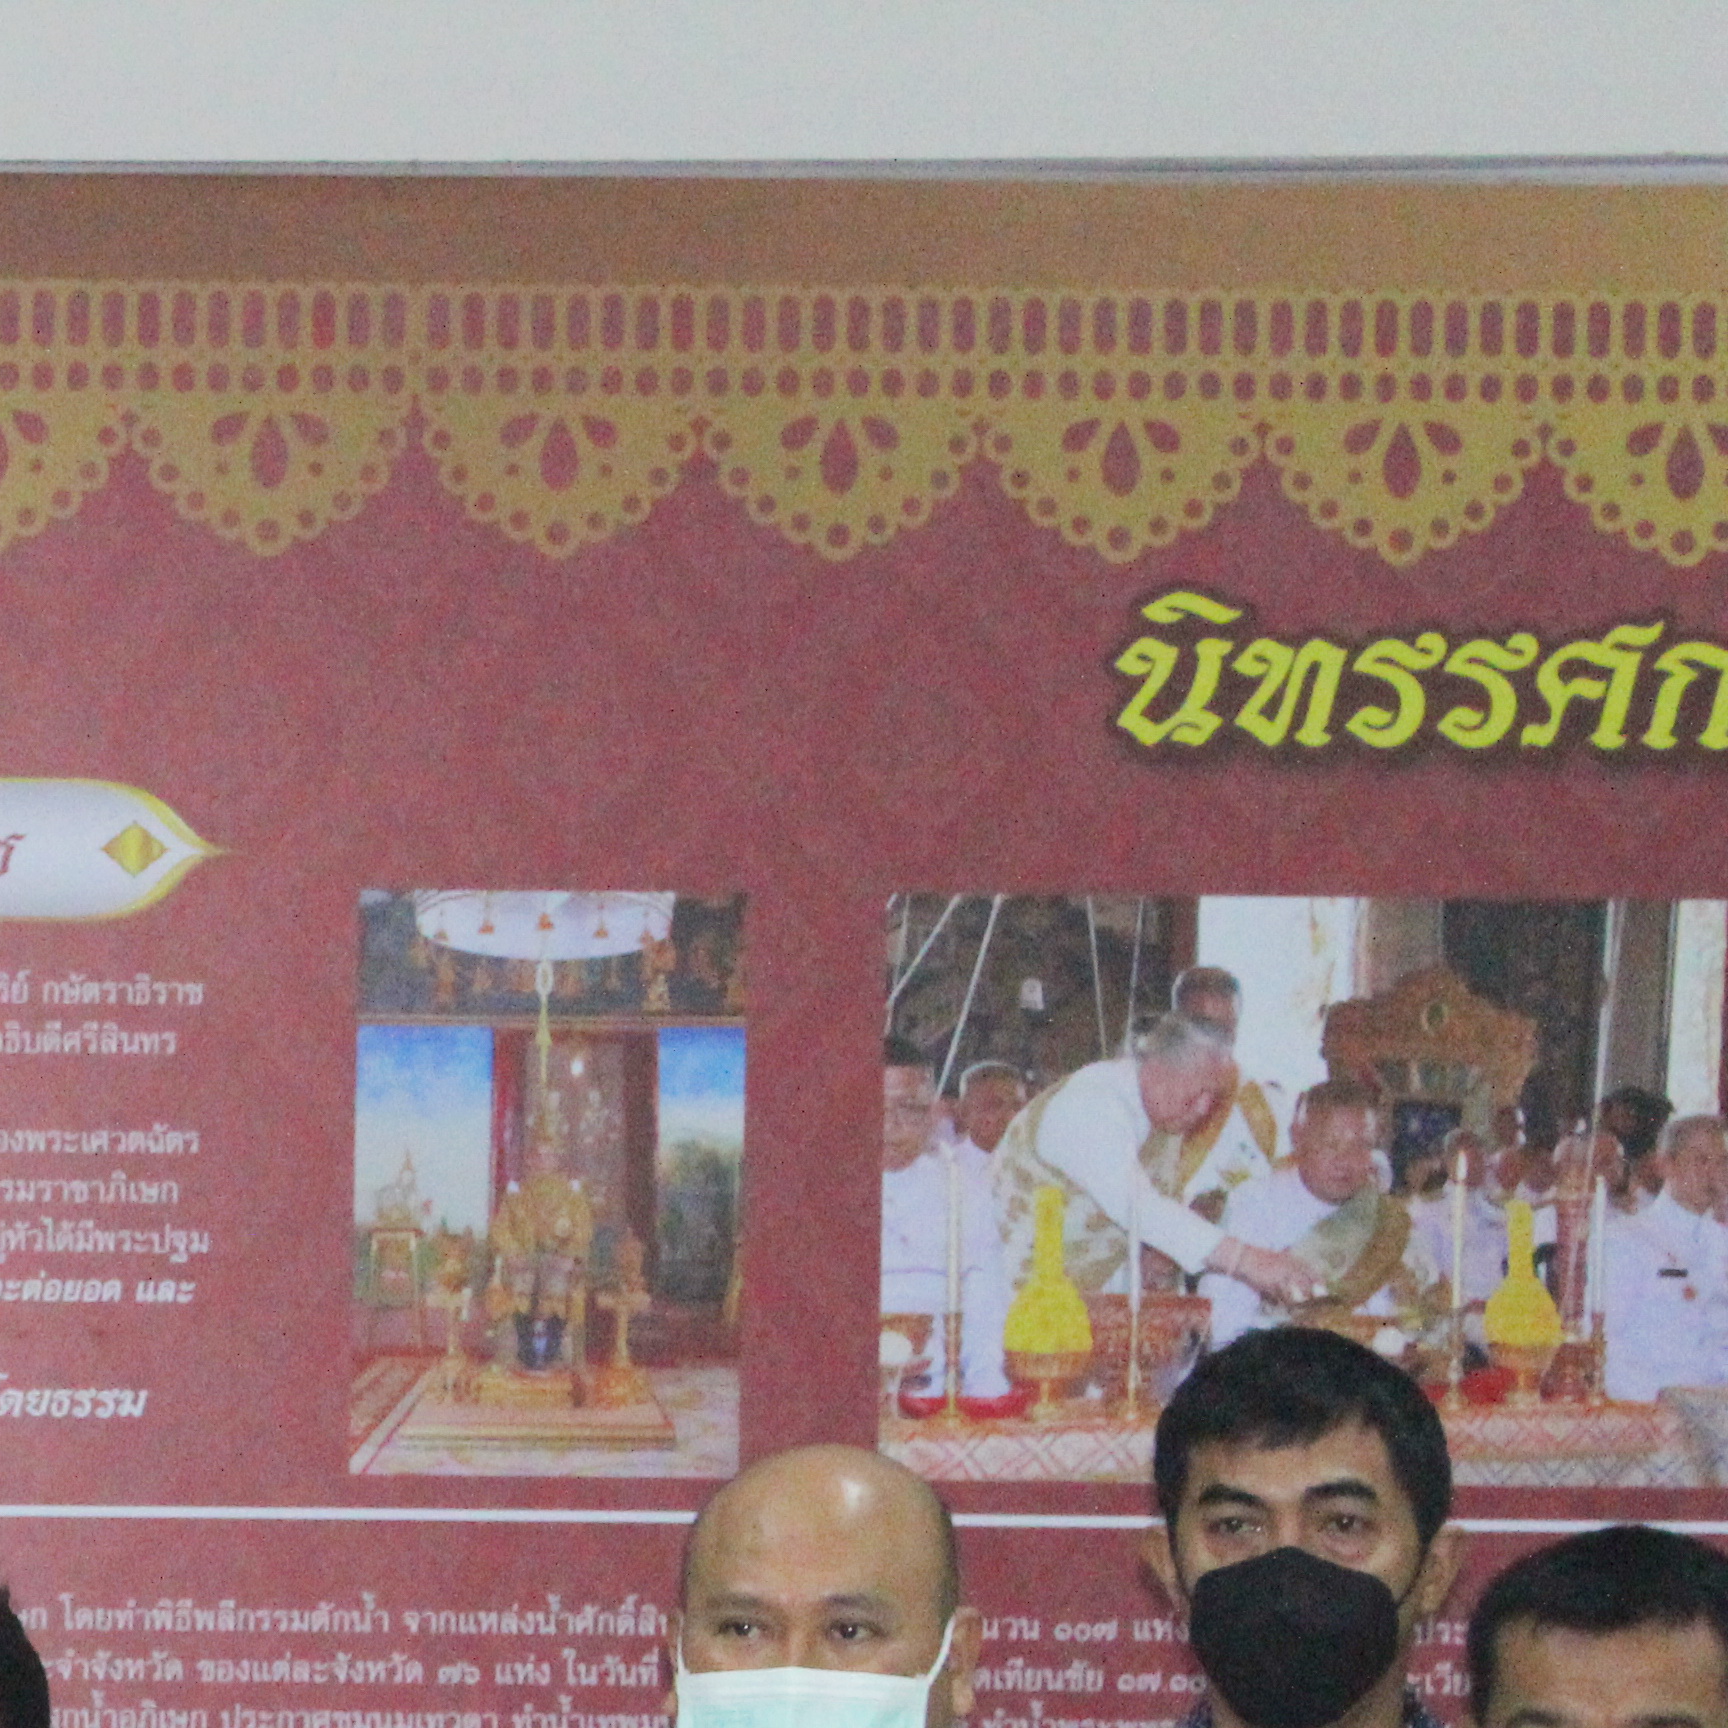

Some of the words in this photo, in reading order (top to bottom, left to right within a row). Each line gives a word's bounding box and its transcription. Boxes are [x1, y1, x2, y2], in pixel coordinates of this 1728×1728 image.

[1113, 591, 1728, 748] นิทรรศก
[136, 1281, 196, 1304] และ
[494, 1652, 551, 1685] แห่ง
